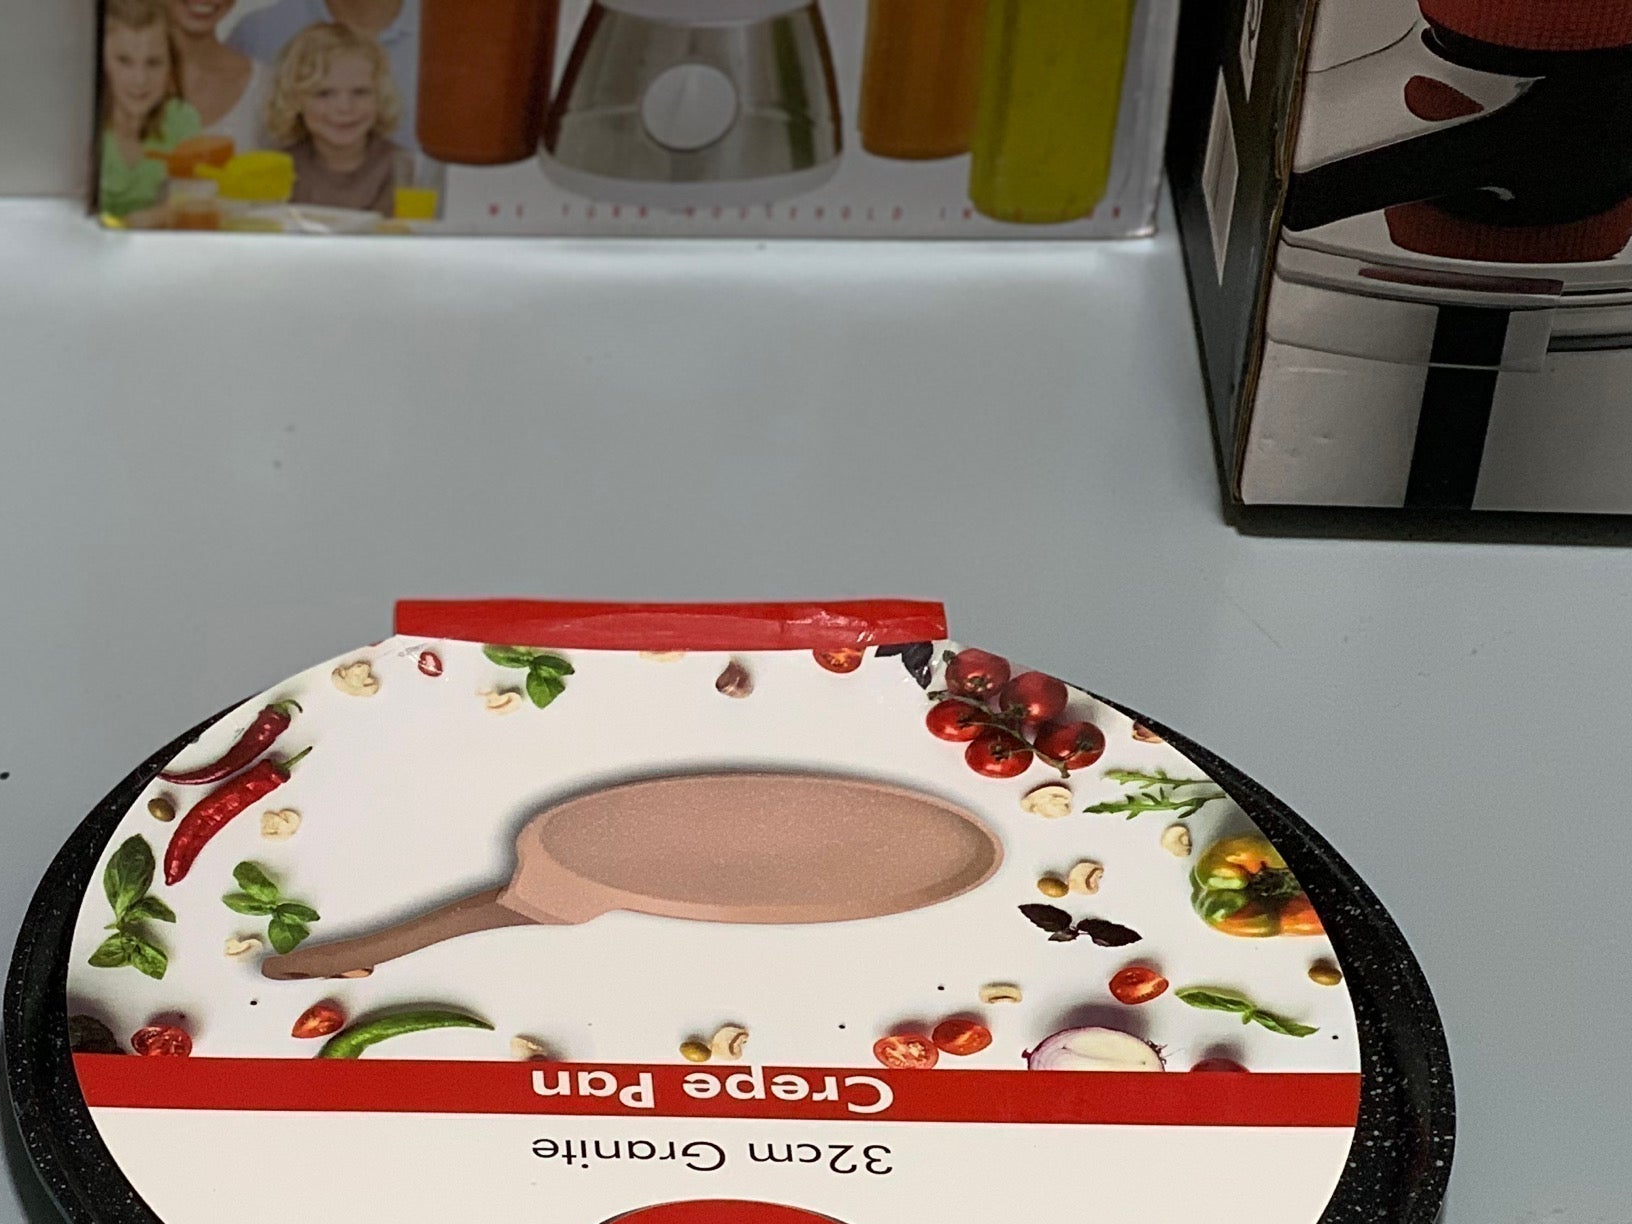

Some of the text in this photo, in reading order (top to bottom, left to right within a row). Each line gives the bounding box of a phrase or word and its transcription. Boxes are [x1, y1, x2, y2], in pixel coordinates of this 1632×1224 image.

[531, 1064, 894, 1114] Crepe Pan
[531, 1138, 893, 1175] 32cm Granite
